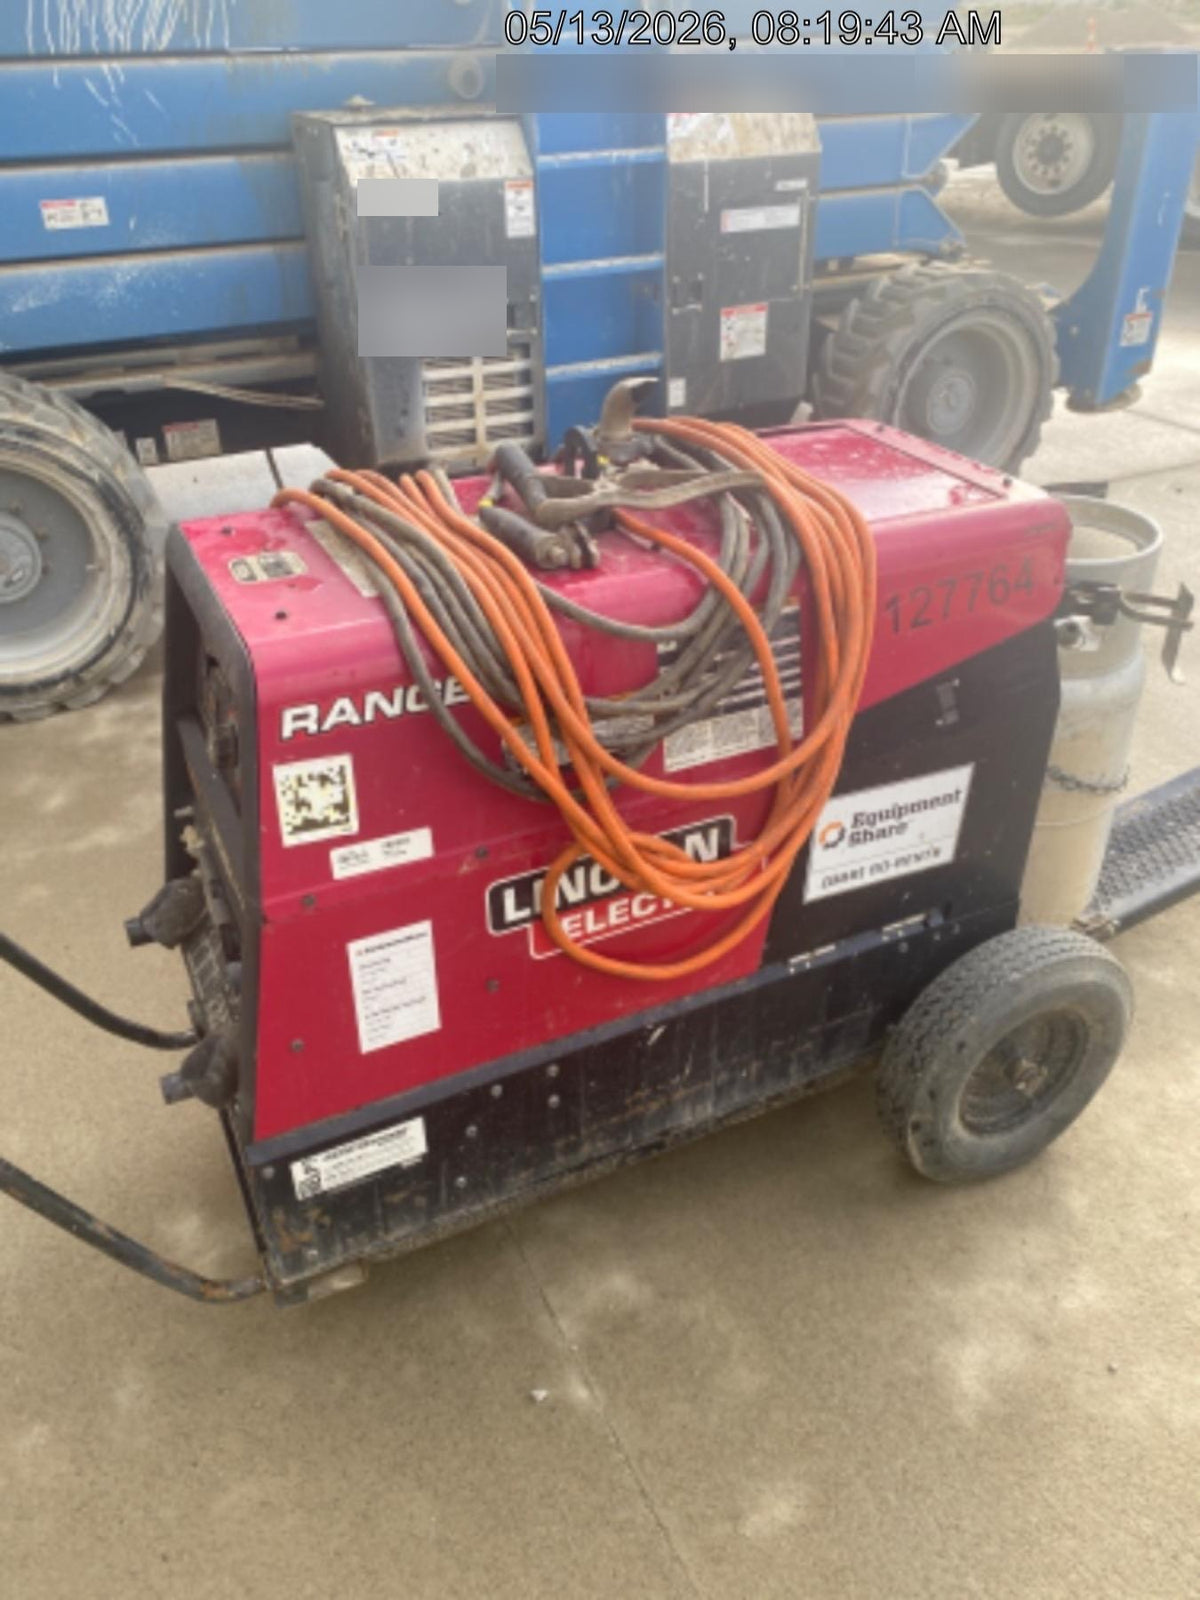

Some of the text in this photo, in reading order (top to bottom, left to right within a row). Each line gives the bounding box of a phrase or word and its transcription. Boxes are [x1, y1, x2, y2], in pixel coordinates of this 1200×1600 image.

[885, 554, 1037, 636] 127764
[280, 674, 473, 741] RANGE
[847, 821, 909, 847] Share
[850, 787, 962, 829] Equipment
[502, 827, 720, 923] LINCN
